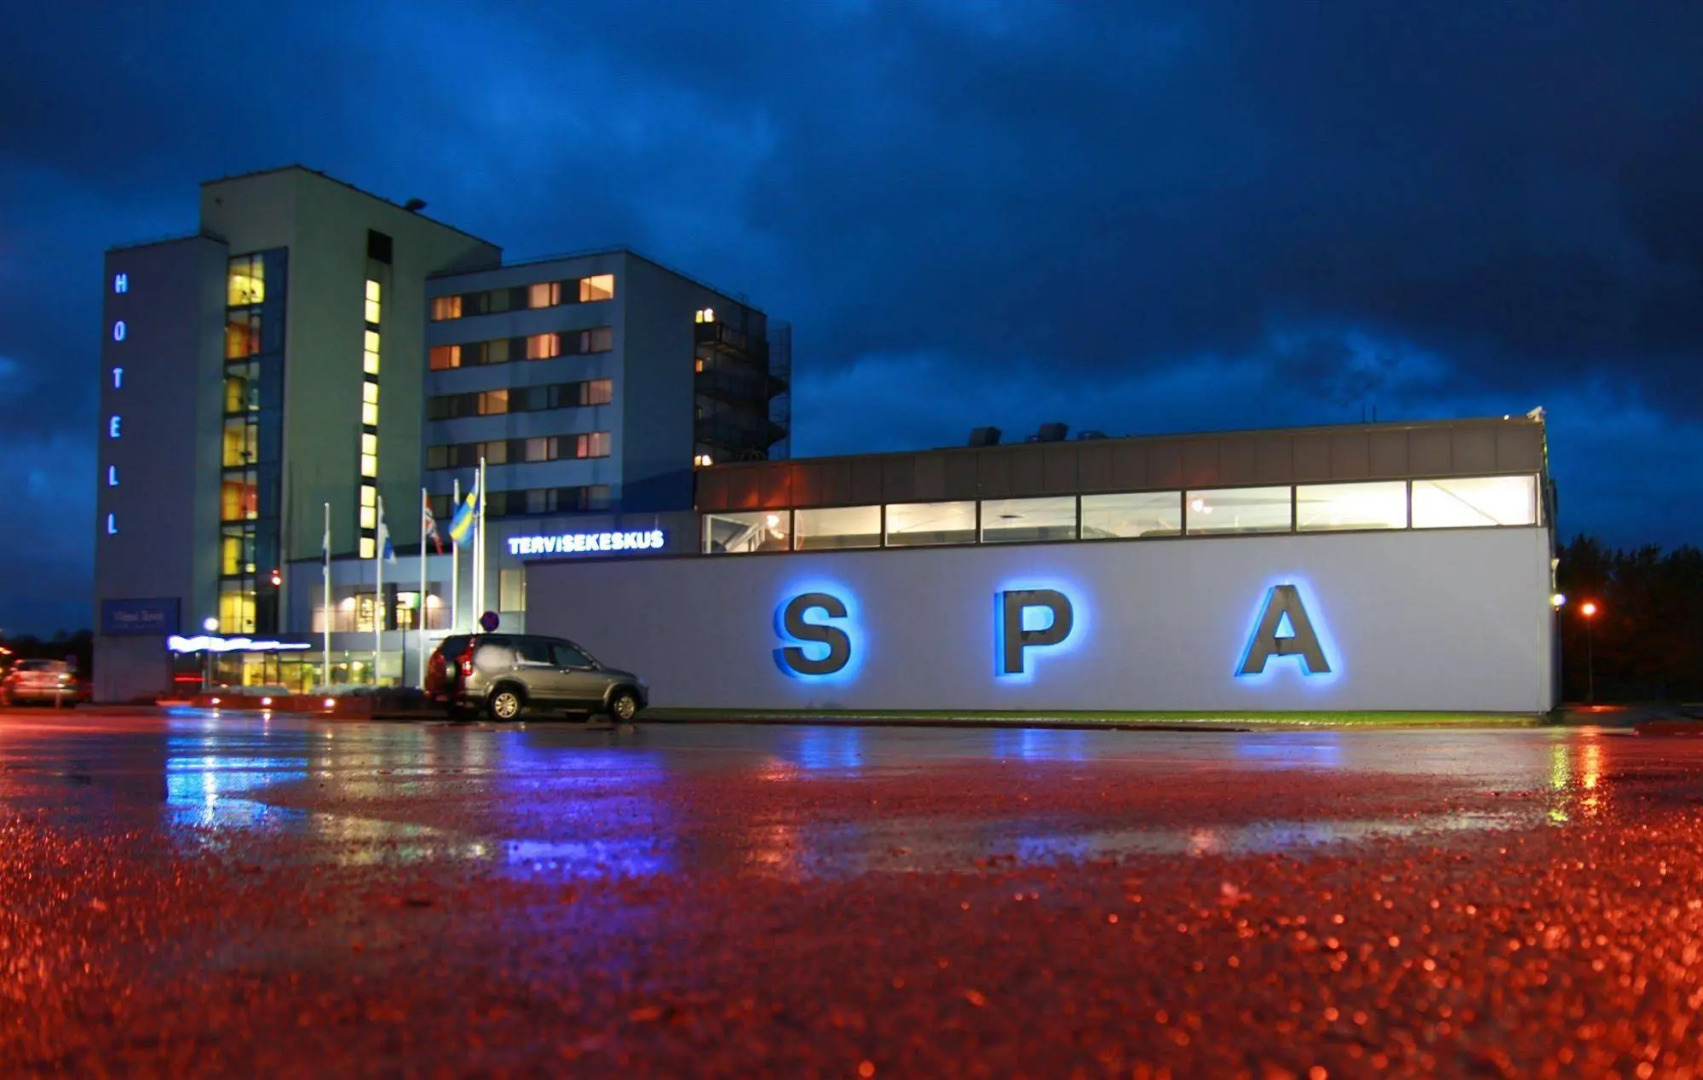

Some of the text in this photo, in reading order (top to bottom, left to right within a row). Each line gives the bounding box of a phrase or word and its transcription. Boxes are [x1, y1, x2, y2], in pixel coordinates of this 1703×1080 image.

[107, 273, 128, 535] HOTELL
[508, 530, 664, 554] TERVISEKESKUS
[774, 584, 1332, 677] SPA
